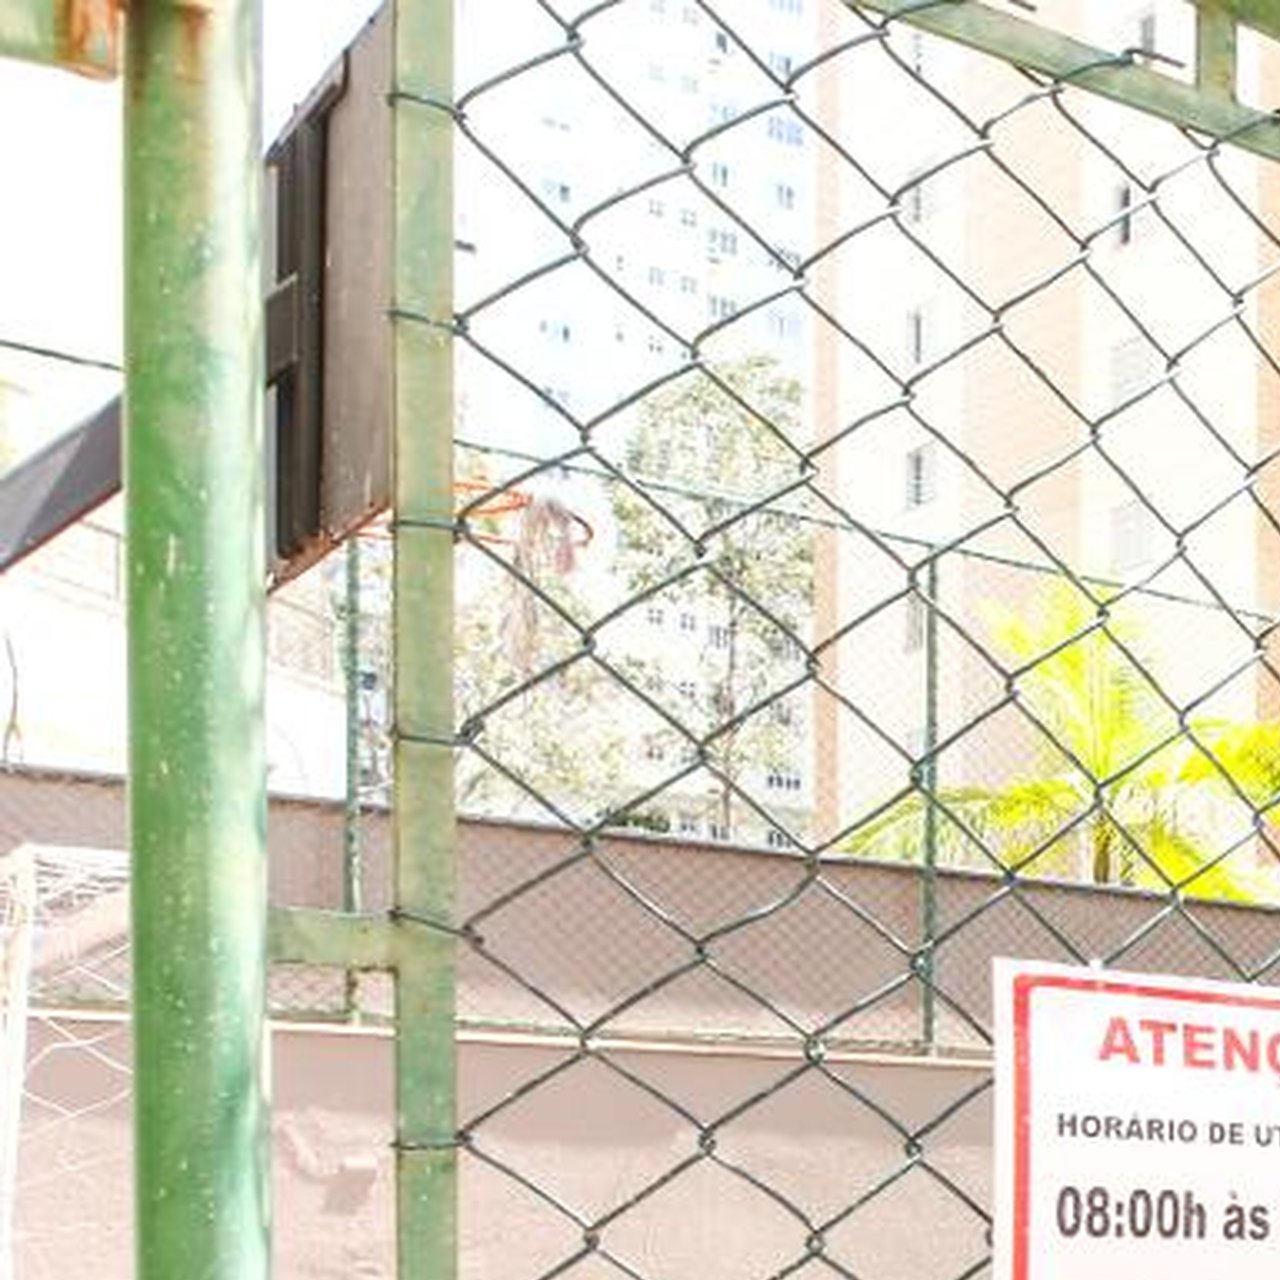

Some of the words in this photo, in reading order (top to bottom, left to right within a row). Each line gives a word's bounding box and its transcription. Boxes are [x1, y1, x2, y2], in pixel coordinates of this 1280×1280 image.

[1057, 1111, 1198, 1144] HORÁRIO
[1208, 1123, 1244, 1144] DE
[1057, 1186, 1206, 1240] 08:00h
[1224, 1191, 1269, 1240] às
